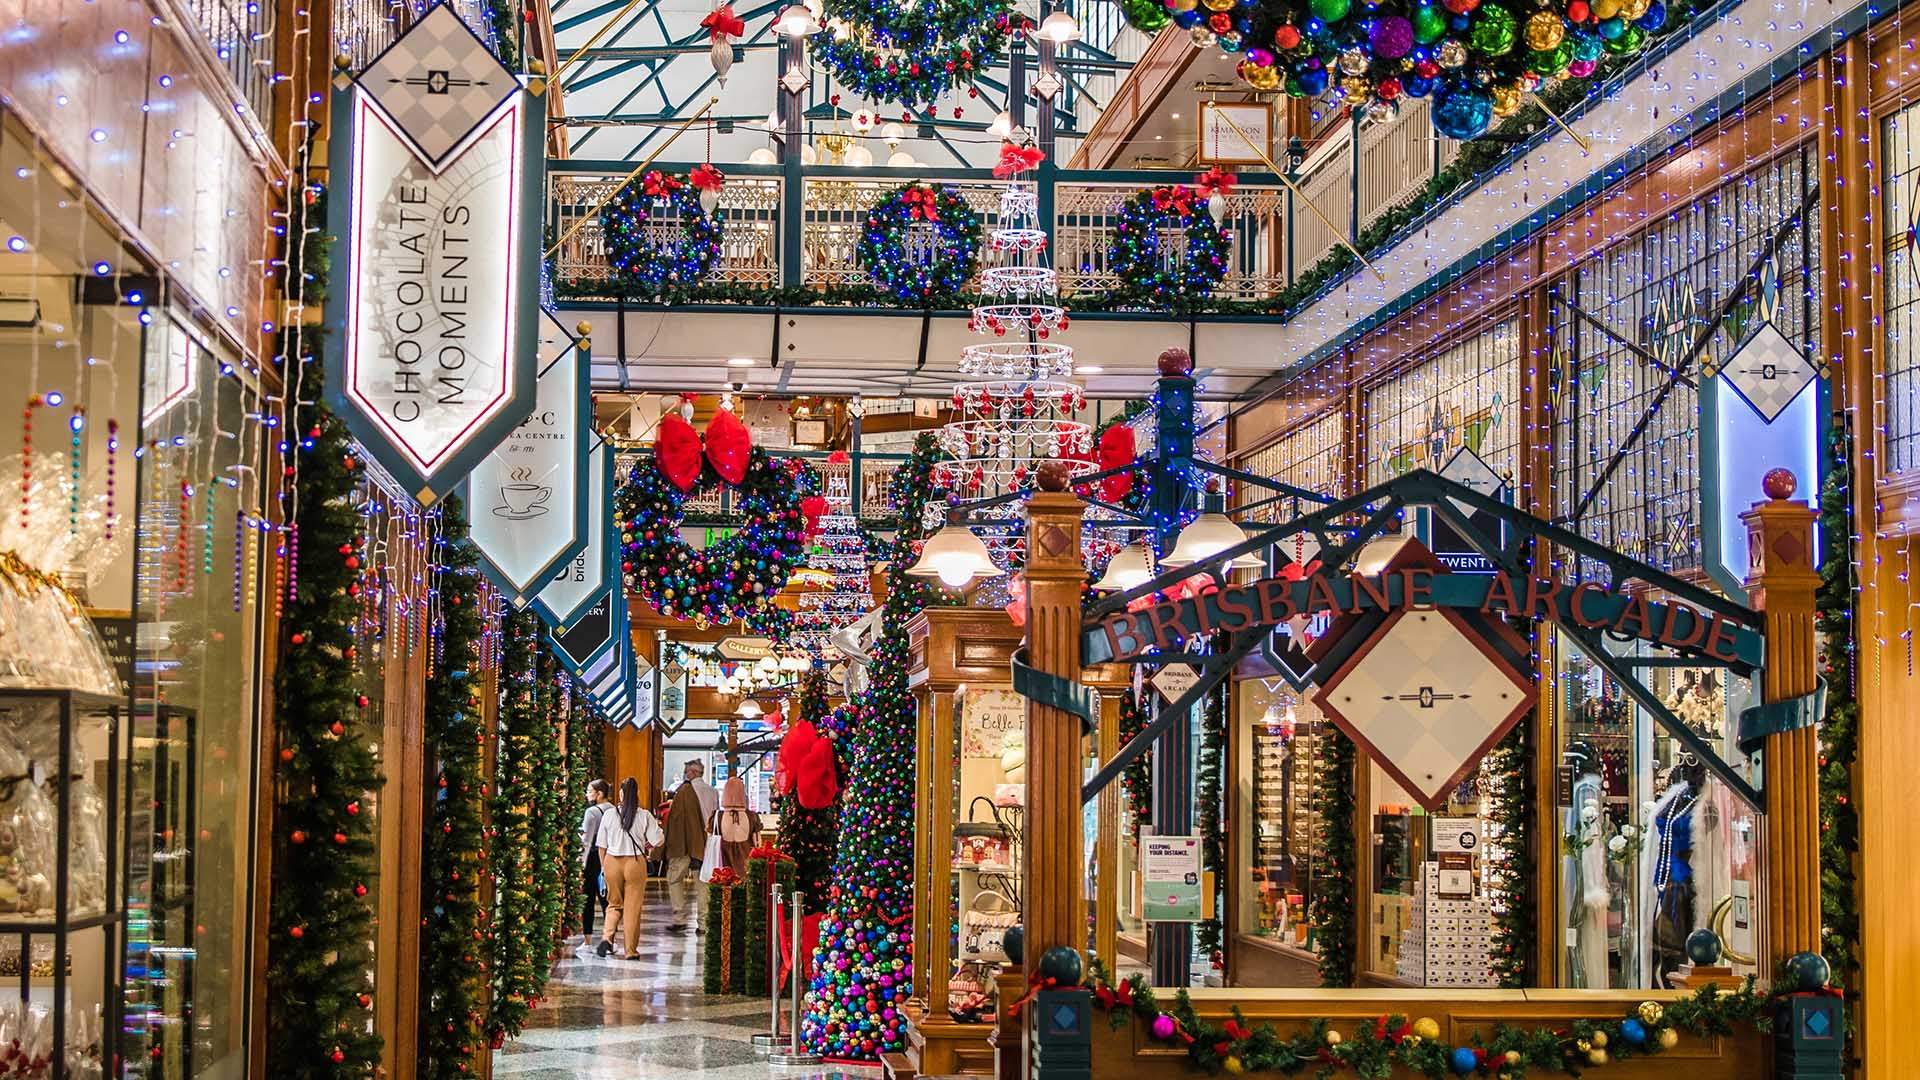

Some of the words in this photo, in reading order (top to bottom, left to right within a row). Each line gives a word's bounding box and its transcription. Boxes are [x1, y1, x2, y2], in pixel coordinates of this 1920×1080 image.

[393, 186, 427, 423] CHOCOLATE
[438, 206, 470, 405] MOMENTS
[729, 641, 765, 655] GALLERY
[1102, 568, 1436, 662] BRISBANE
[1479, 570, 1743, 662] ARCADE
[982, 712, 1013, 732] Belle
